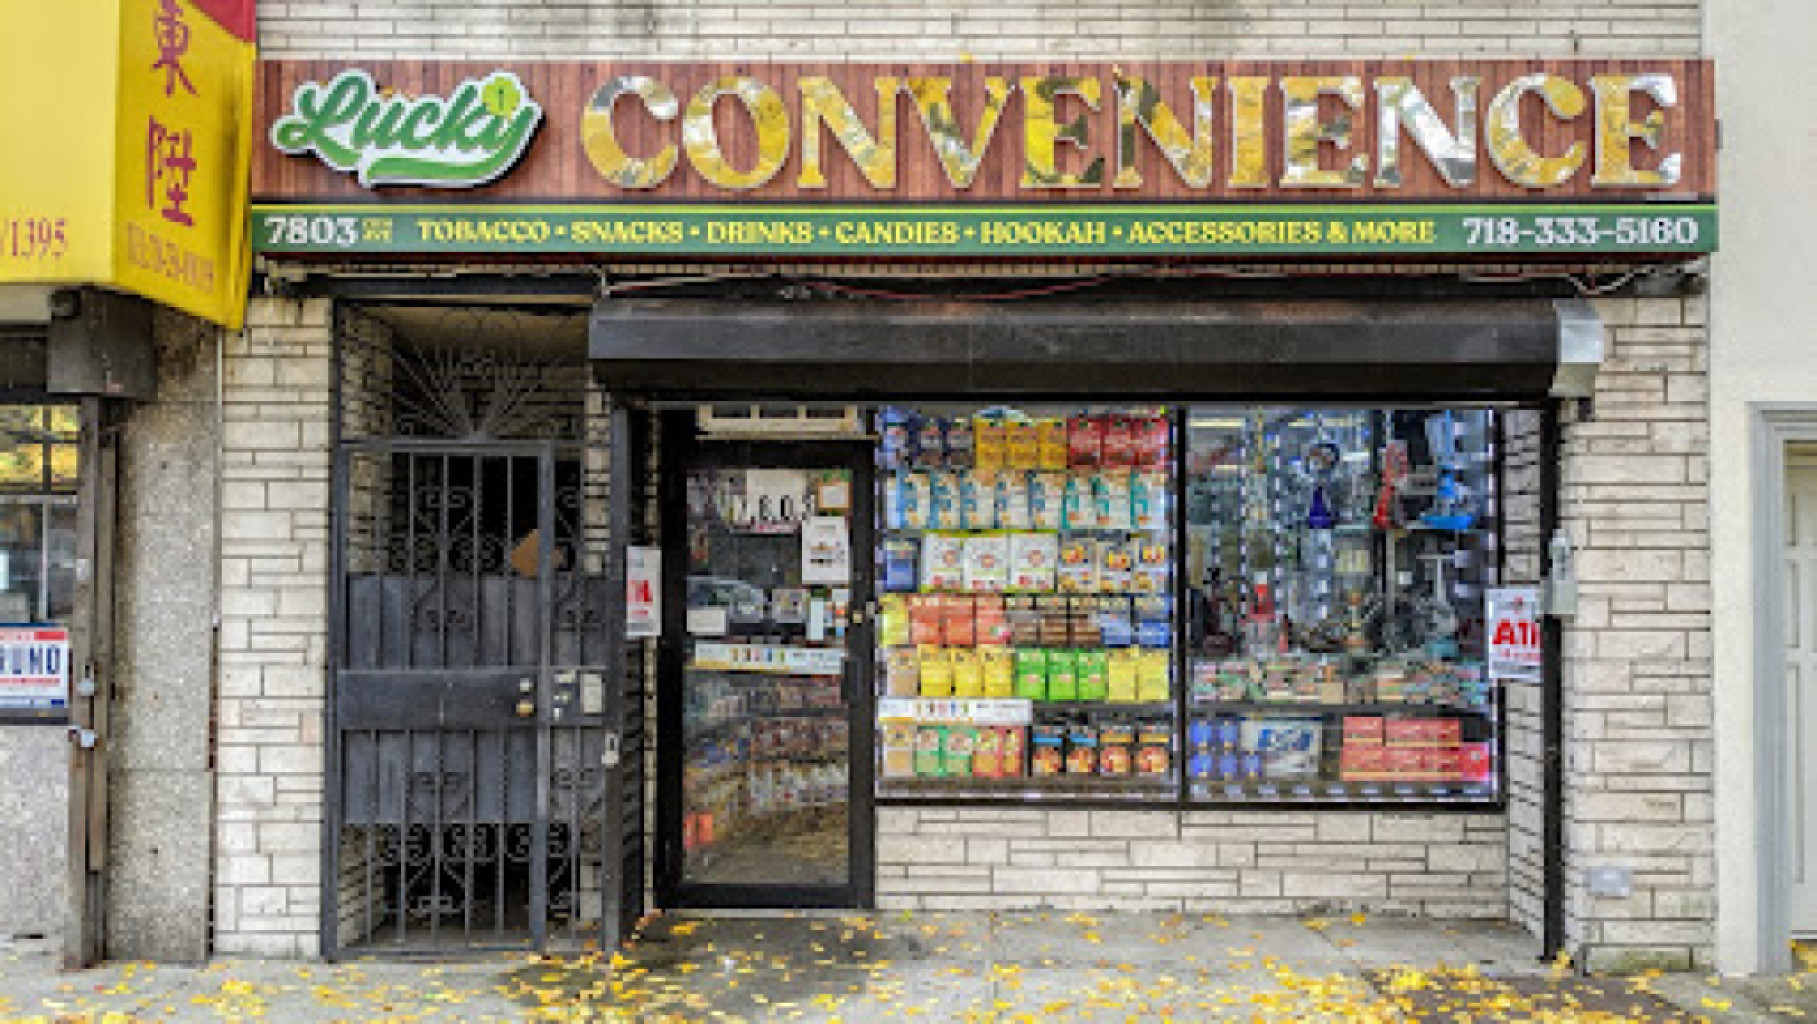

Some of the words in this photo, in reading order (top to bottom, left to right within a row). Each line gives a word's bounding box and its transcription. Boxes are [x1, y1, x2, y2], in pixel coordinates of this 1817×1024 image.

[272, 71, 538, 184] Lucky
[580, 74, 1682, 190] CONVENIENCE
[264, 216, 359, 247] 7803
[416, 219, 550, 244] TOBACCO
[570, 220, 684, 244] SNACKS
[707, 220, 813, 244] DRINKS
[835, 220, 960, 244] CANDIES
[980, 220, 1106, 244] HOOKAH
[1126, 220, 1323, 244] ACCESSORIES
[1326, 220, 1349, 244] &
[1351, 220, 1435, 244] MORE
[1462, 217, 1699, 247] 718-333-5160
